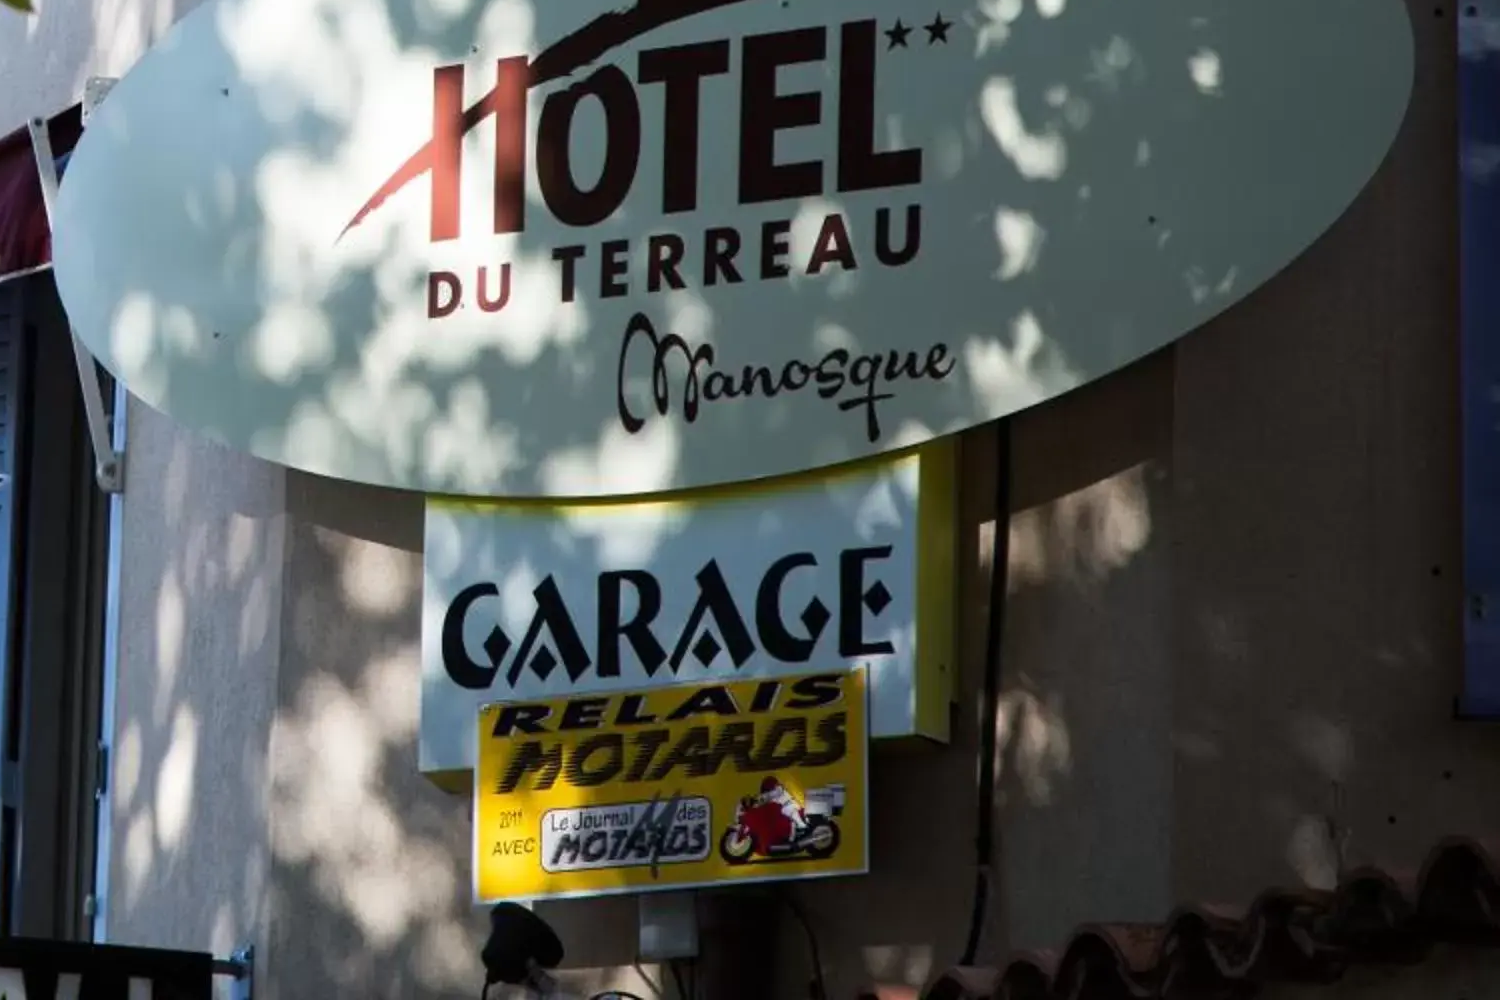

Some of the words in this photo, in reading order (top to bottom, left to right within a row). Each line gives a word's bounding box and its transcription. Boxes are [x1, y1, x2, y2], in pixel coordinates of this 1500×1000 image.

[427, 263, 511, 319] DU
[552, 204, 921, 303] TERREAU
[617, 312, 956, 443] Manosque
[441, 545, 895, 690] GARAGE
[492, 674, 845, 738] RELAIS
[493, 711, 848, 795] MOTARDS
[492, 837, 536, 857] AVEC
[551, 814, 569, 831] Le
[573, 806, 634, 831] Journal
[676, 803, 707, 821] des
